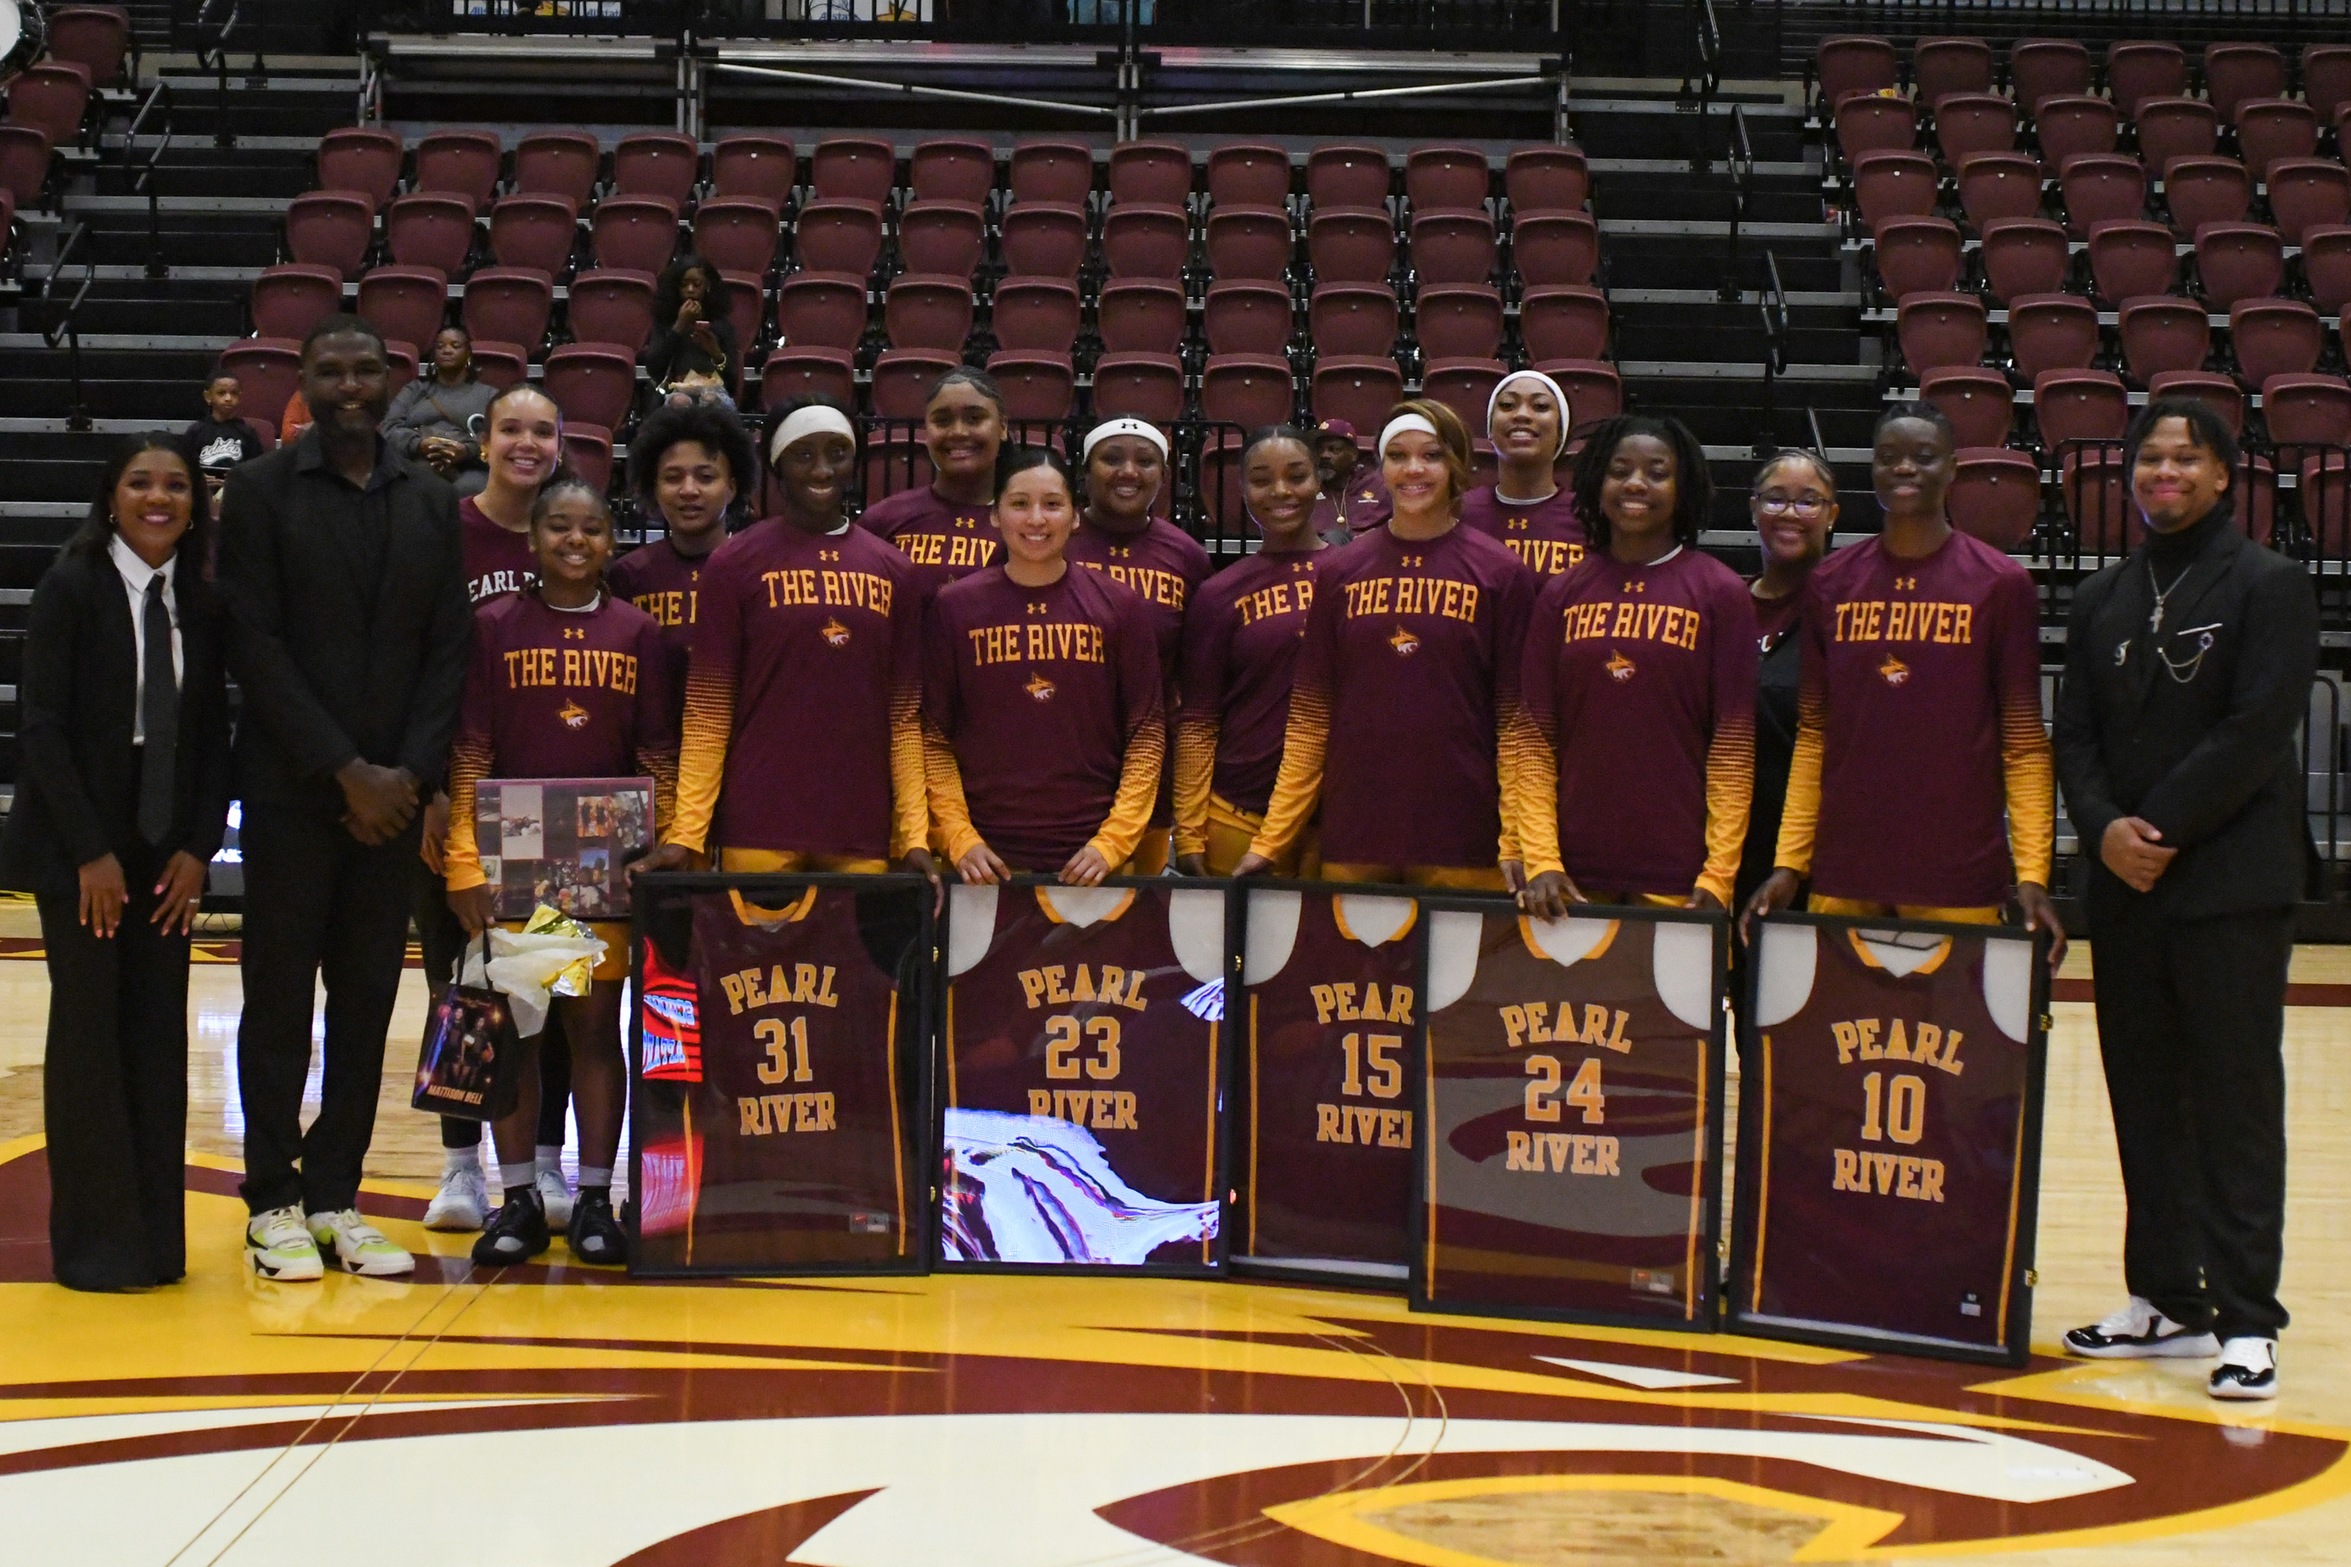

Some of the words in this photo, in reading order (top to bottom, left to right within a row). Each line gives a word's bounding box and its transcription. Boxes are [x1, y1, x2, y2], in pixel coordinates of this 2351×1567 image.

[762, 569, 819, 608] THE
[822, 570, 892, 618] RIVER
[1234, 584, 1291, 626] THE
[1344, 578, 1393, 619] THE
[1395, 577, 1478, 623] RIVER
[968, 624, 1021, 666] THE
[1027, 624, 1105, 664] RIVER
[1564, 602, 1612, 644] THE
[1611, 602, 1700, 651] RIVER
[1835, 601, 1885, 642] THE
[1885, 601, 1972, 644] RIVER
[504, 648, 556, 689] THE
[563, 649, 638, 695] RIVER
[720, 963, 838, 1016] PEARL
[1017, 963, 1148, 1011] PEARL
[1310, 982, 1414, 1025] PEAR
[754, 1016, 813, 1085] 31
[1046, 1015, 1121, 1080] 23
[1499, 1001, 1632, 1054] PEARL
[1831, 1018, 1964, 1076] PEARL
[1342, 1032, 1402, 1099] 15
[1525, 1054, 1605, 1124] 24
[737, 1092, 836, 1136] RIVER
[1028, 1089, 1138, 1130] RIVER
[1861, 1071, 1926, 1145] 10
[1506, 1130, 1620, 1176] RIVER
[1833, 1148, 1944, 1203] RIVER
